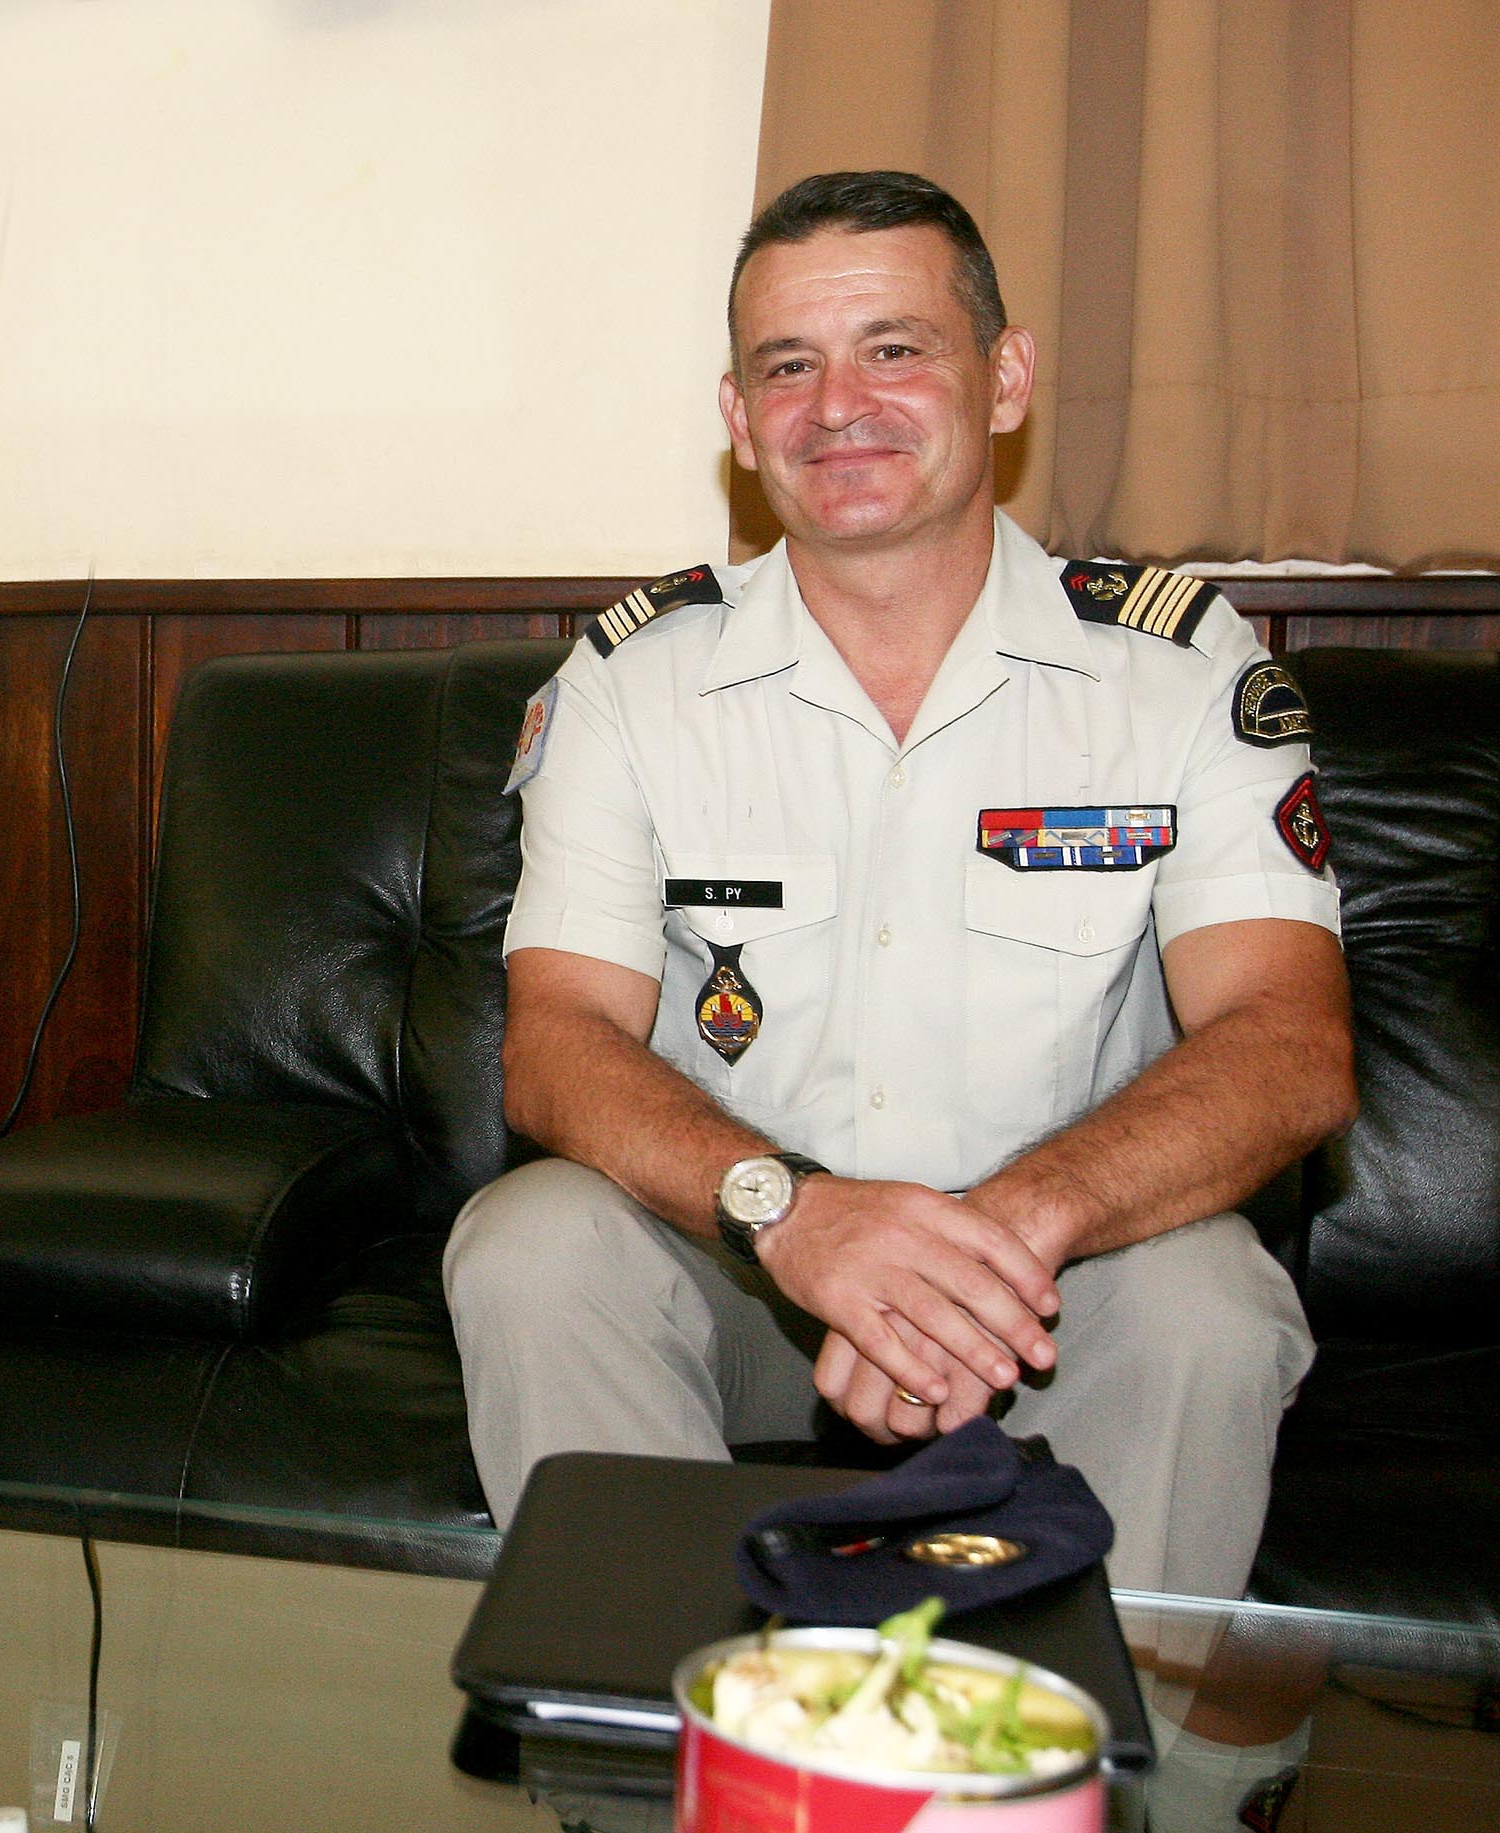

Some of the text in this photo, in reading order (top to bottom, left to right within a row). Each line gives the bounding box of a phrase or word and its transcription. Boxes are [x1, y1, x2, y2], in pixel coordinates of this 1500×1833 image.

[704, 887, 742, 900] S. PY
[63, 1762, 73, 1784] CAC
